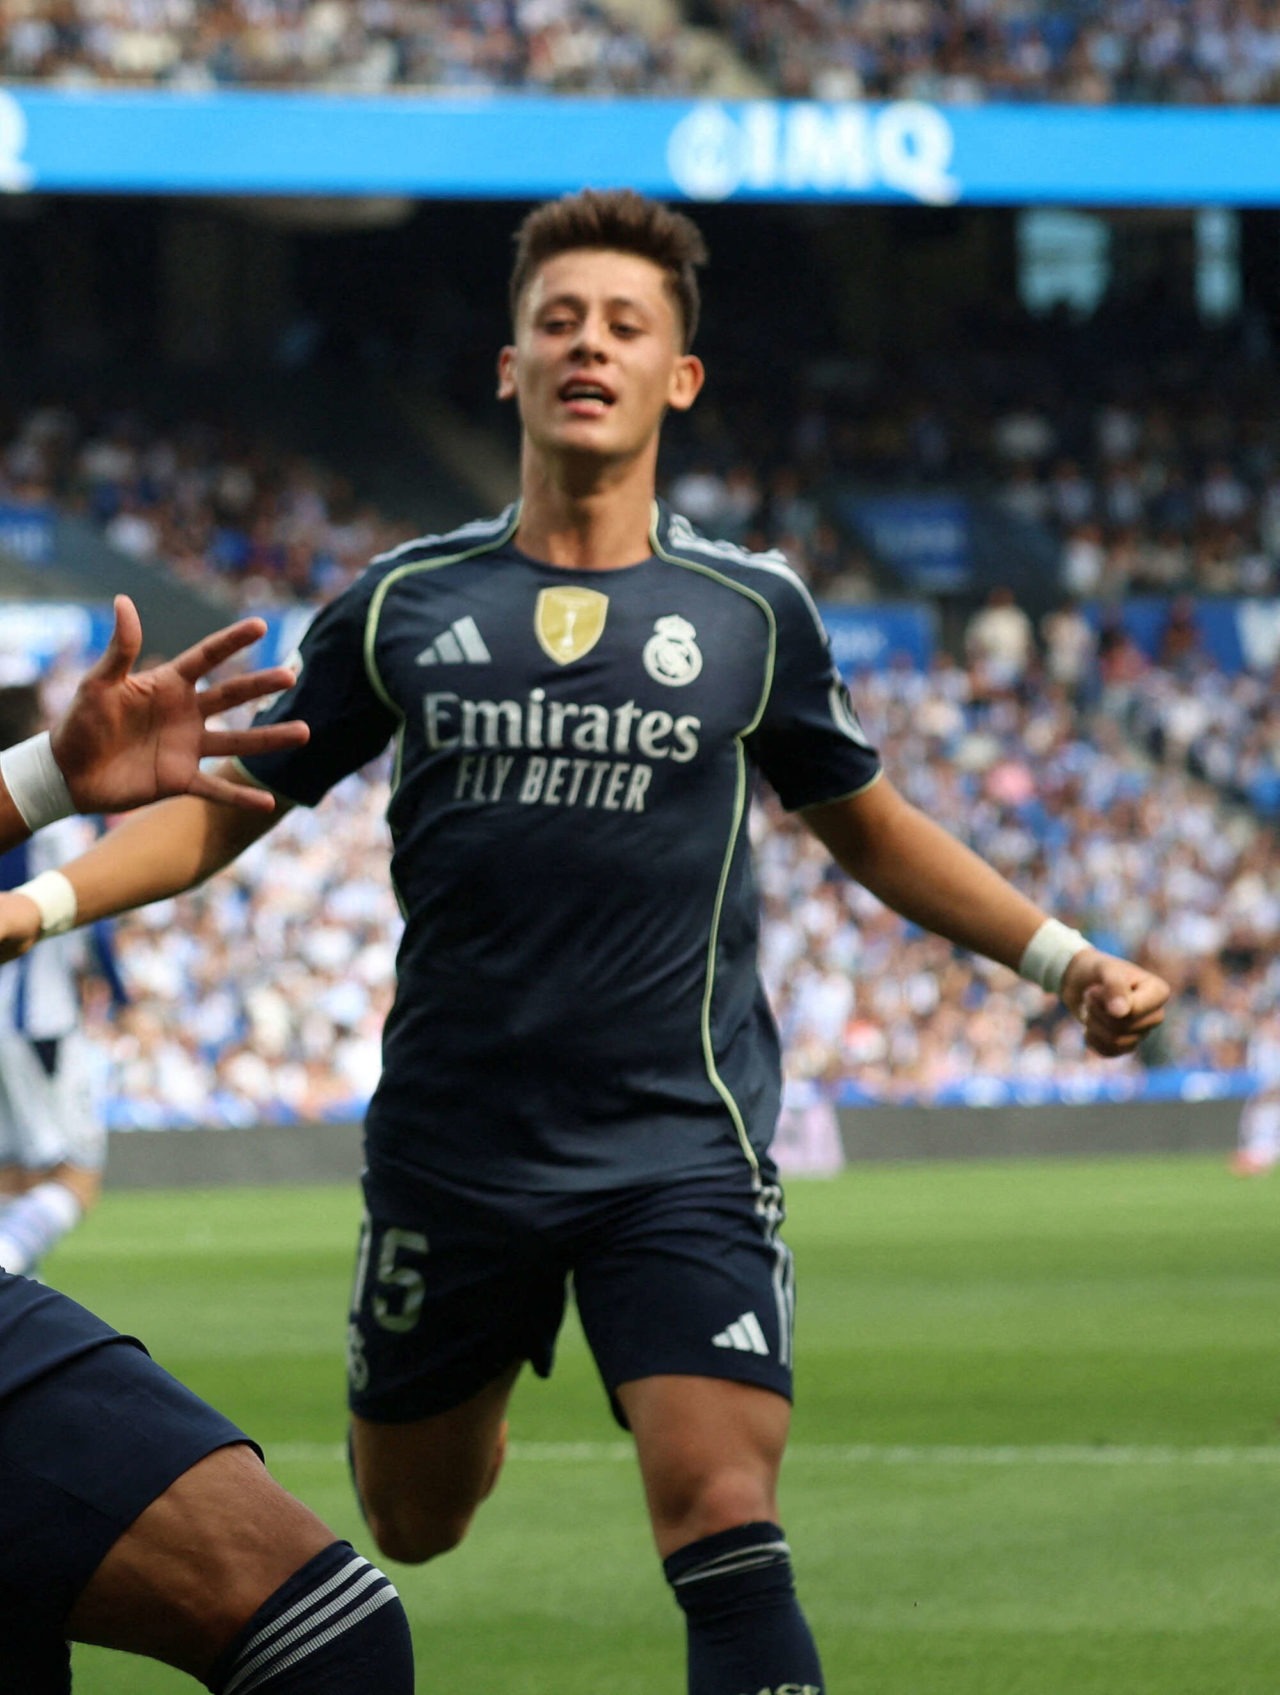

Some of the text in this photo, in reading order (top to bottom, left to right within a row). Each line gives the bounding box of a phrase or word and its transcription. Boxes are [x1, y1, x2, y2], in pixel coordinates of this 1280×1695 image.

[743, 100, 961, 206] IMQ
[424, 687, 701, 763] Emirates
[454, 754, 652, 813] FLY BETTER
